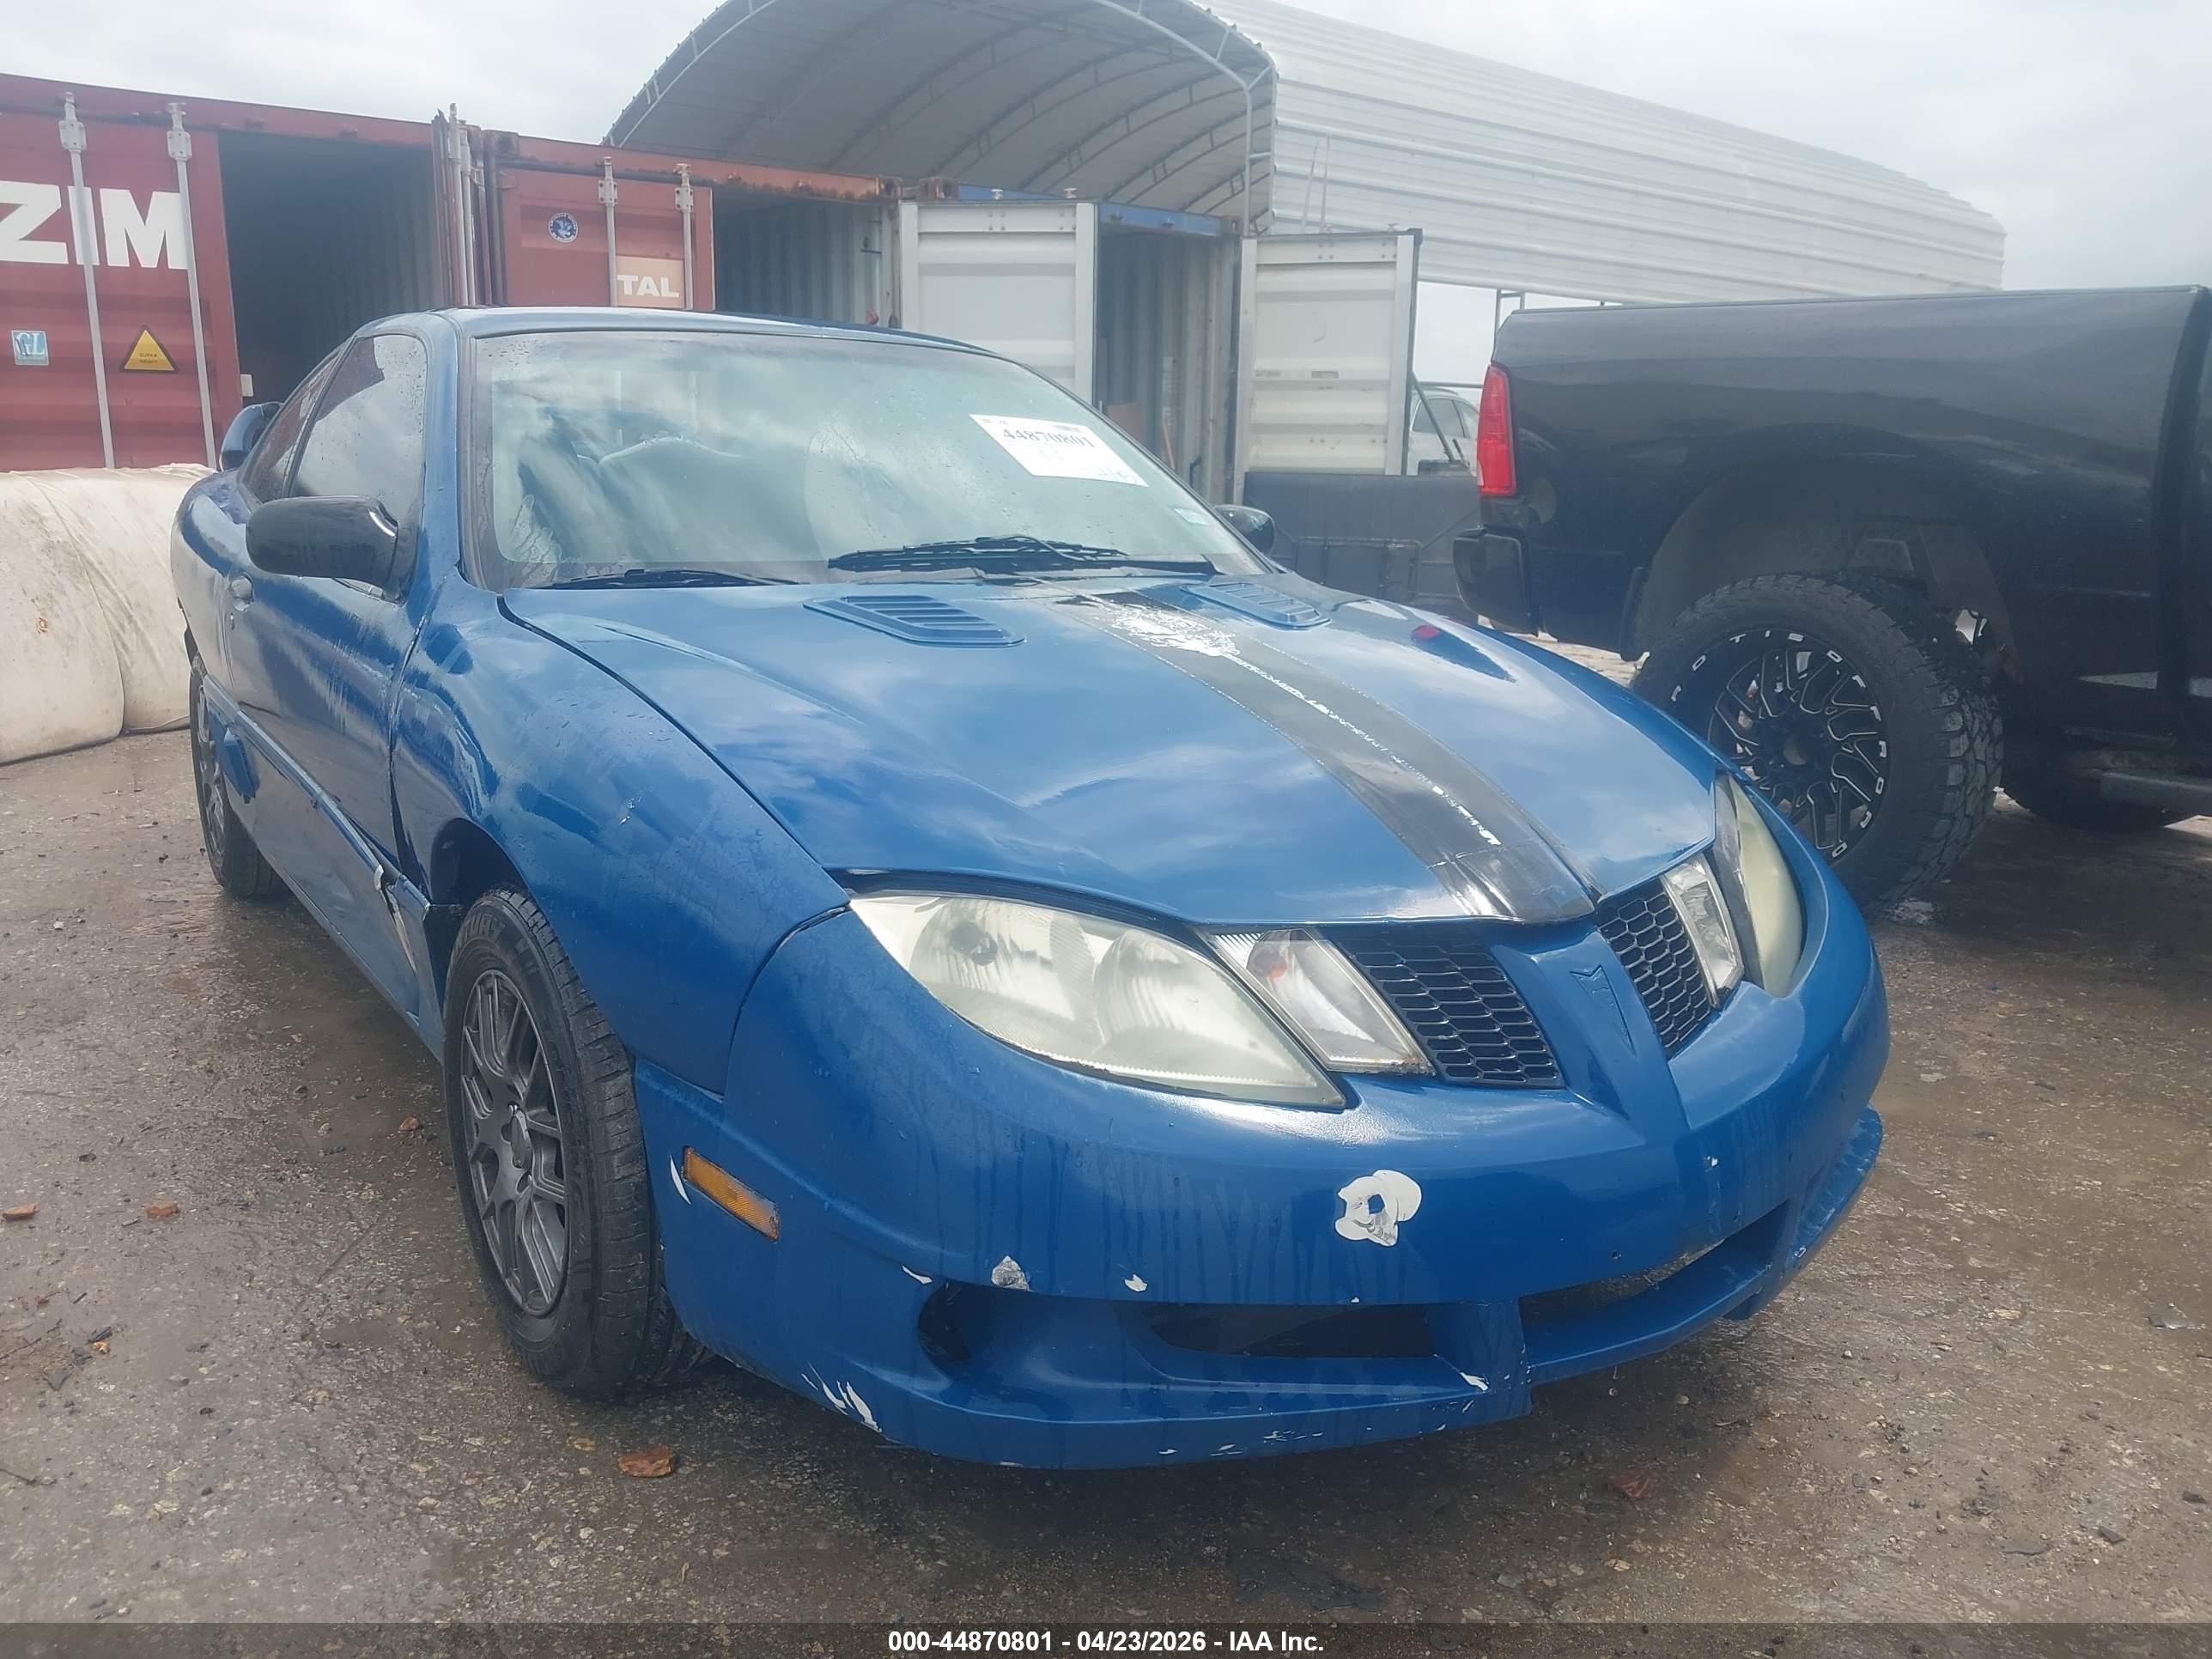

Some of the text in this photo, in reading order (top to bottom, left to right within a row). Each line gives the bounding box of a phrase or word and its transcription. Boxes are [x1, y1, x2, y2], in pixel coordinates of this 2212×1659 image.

[0, 180, 191, 270] ZIM
[617, 274, 679, 298] TAL
[1003, 428, 1095, 447] 44870801
[1729, 629, 1804, 643] TIS
